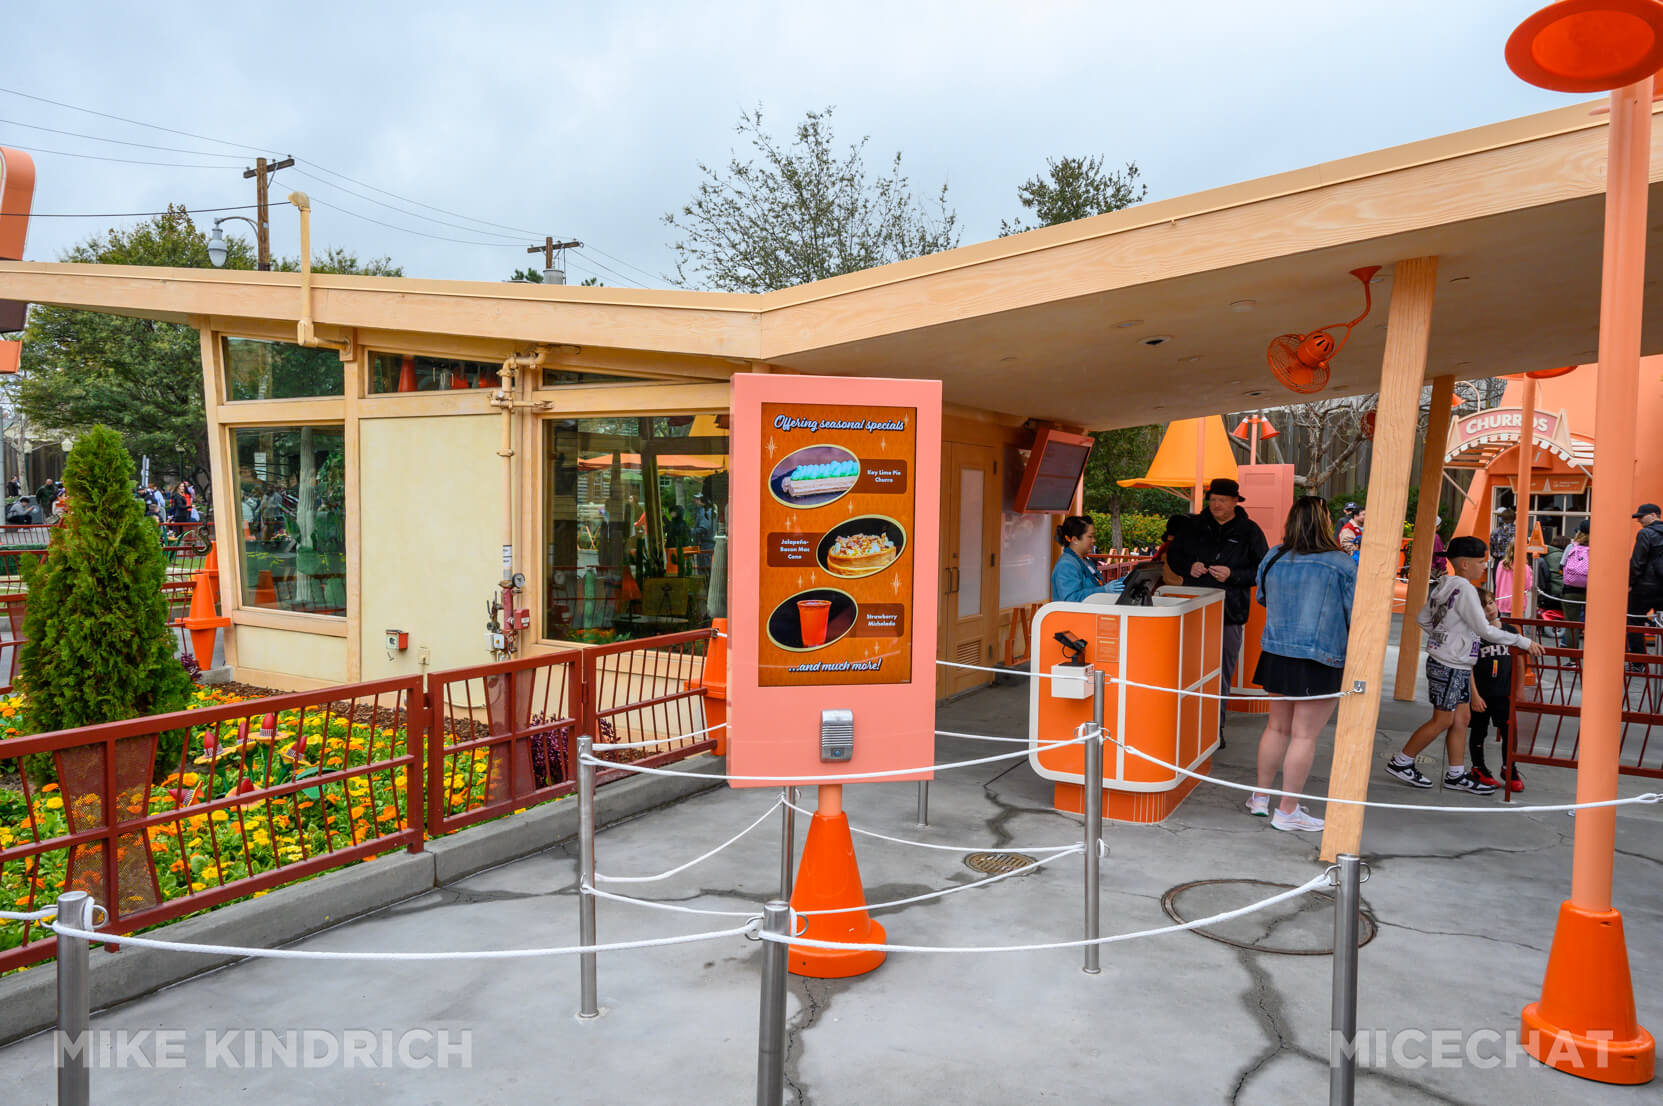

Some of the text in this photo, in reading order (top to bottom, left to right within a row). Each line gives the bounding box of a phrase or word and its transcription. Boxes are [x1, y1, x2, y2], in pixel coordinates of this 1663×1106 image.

[774, 414, 905, 433] Offering seasonal specials
[867, 469, 878, 477] Key
[1480, 645, 1511, 658] PHX
[788, 657, 883, 673] ...and much more!
